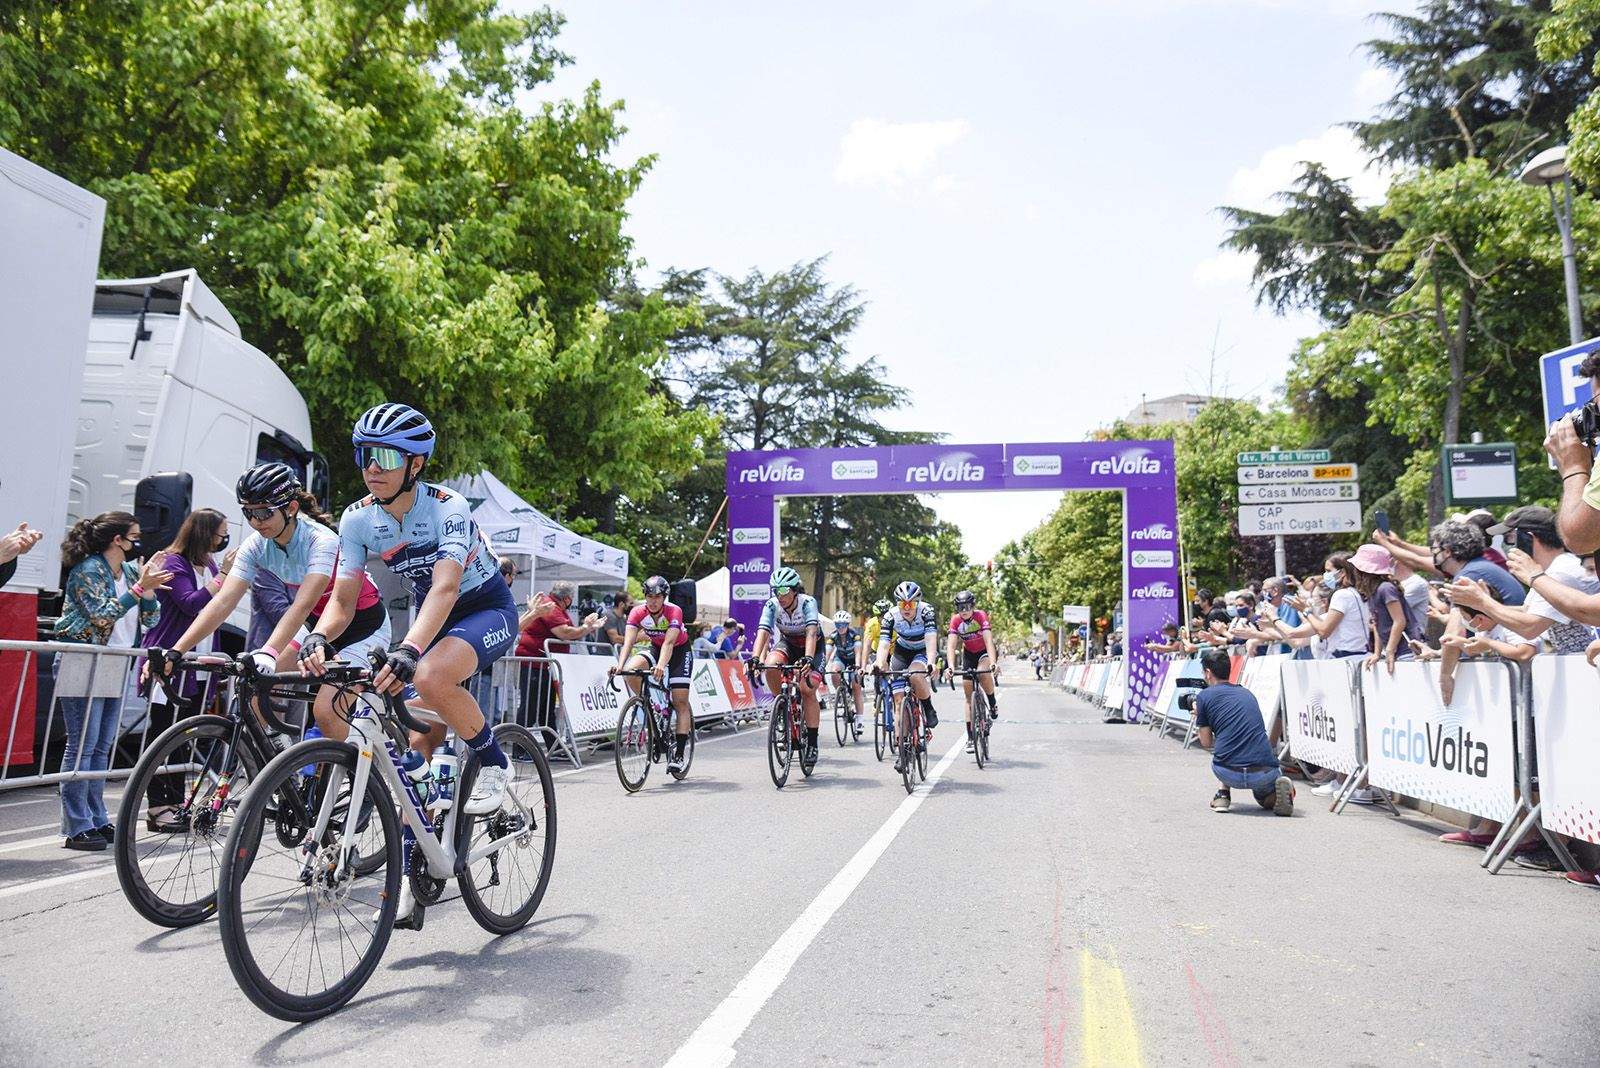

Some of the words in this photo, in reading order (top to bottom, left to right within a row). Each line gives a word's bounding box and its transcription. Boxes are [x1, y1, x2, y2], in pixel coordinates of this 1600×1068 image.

[1559, 352, 1592, 406] P
[739, 464, 805, 483] reVolta
[905, 461, 985, 482] reVolta
[1090, 456, 1161, 475] reVolta
[1257, 468, 1309, 479] Barcelona
[1314, 467, 1350, 478] BP-1417
[1257, 488, 1287, 498] Casa
[1257, 507, 1283, 518] CAP
[1257, 520, 1285, 531] Sant
[1289, 518, 1324, 532] Cugat
[1131, 527, 1173, 540] reVolta
[732, 560, 771, 573] reVolta
[1132, 585, 1175, 598] reVolta
[580, 685, 618, 711] reVolta
[1298, 704, 1336, 743] reVolta
[1381, 716, 1489, 778] cicloVolta
